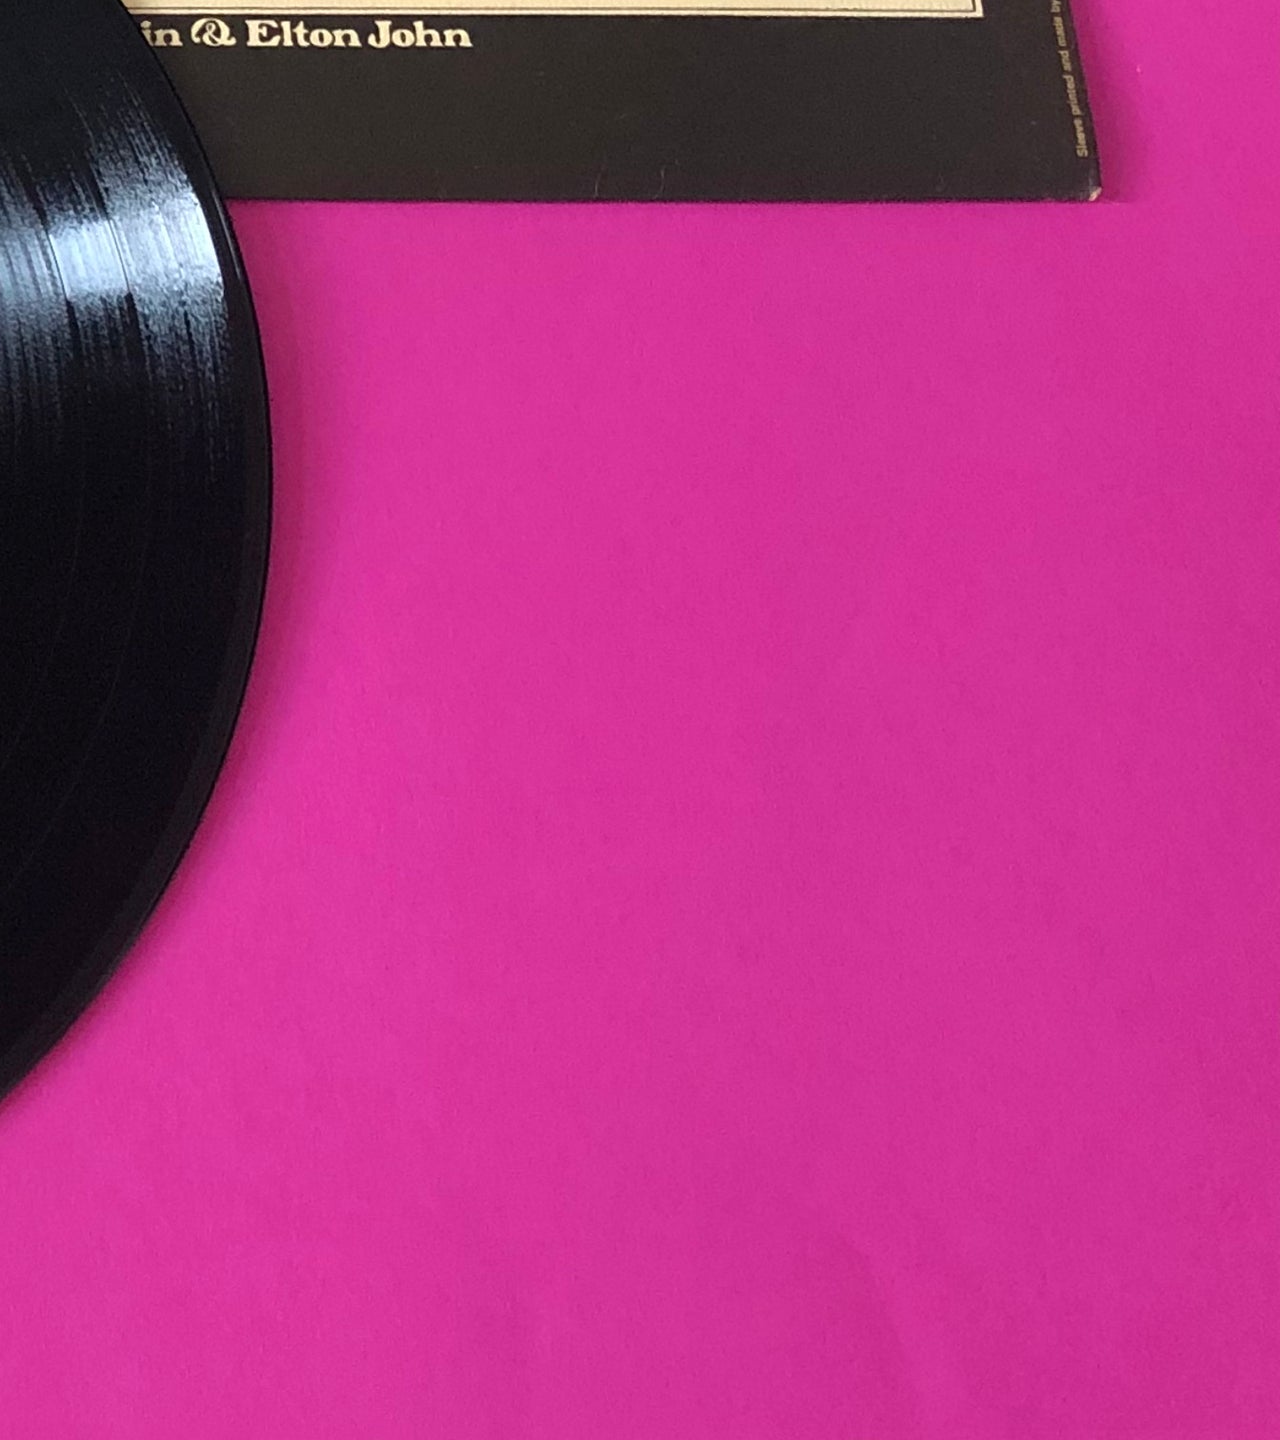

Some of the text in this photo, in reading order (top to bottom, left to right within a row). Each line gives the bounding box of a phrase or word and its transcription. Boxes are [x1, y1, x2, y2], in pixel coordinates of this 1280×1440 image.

[1051, 0, 1062, 14] by
[246, 19, 362, 48] Elton
[367, 20, 473, 49] John
[1054, 16, 1068, 47] made
[1060, 50, 1070, 72] and
[1064, 74, 1082, 116] printed
[1073, 119, 1088, 158] Sleeve
